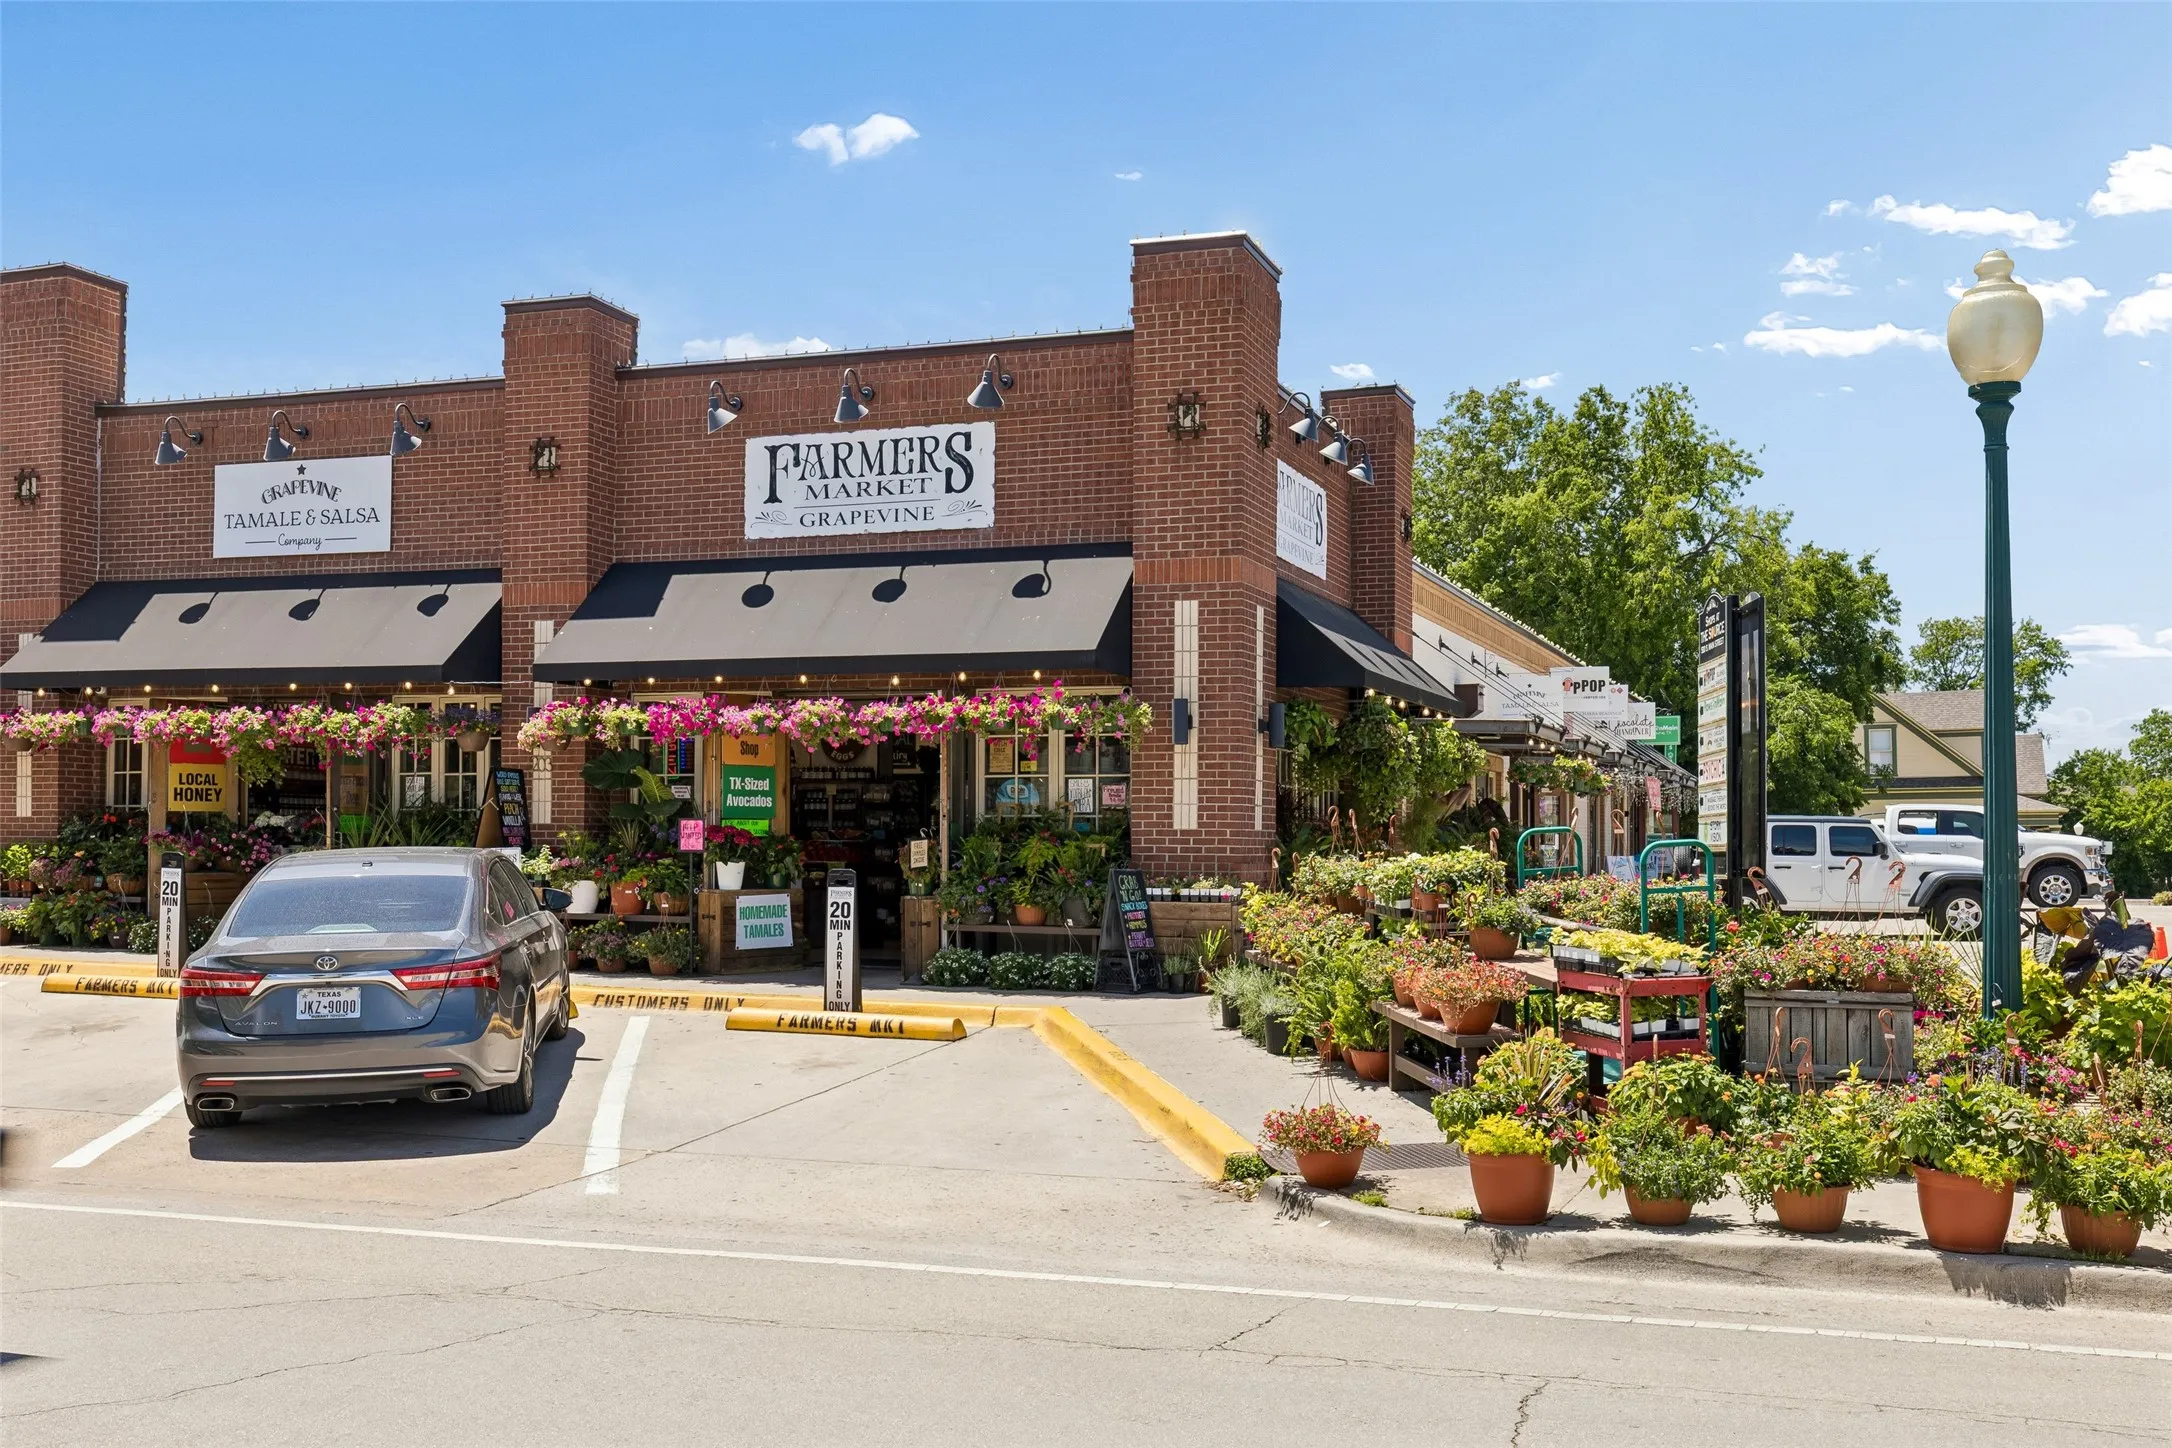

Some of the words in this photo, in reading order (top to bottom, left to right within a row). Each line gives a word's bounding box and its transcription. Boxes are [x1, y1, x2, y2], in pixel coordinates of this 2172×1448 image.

[763, 431, 974, 504] FARMERS
[261, 479, 342, 504] GRAPEVINE
[804, 477, 933, 500] MARKET
[1278, 471, 1323, 546] ARMERS
[224, 511, 301, 529] TAMALE
[305, 509, 316, 525] &
[320, 507, 380, 525] SALSA
[800, 506, 935, 528] GRAPEVINE
[1280, 510, 1313, 540] MARKET
[277, 533, 322, 550] Company
[1278, 535, 1314, 565] GRAPEVINE
[740, 741, 759, 759] Shop
[830, 750, 855, 760] EGGS
[178, 772, 218, 786] LOCAL
[729, 777, 769, 791] TX-Sized
[173, 787, 222, 802] HONEY
[726, 794, 772, 808] Avocados
[162, 881, 178, 896] 20
[1118, 874, 1138, 890] GRAB
[162, 897, 178, 906] MIN
[739, 904, 788, 920] HOMEMADE
[830, 902, 851, 919] 20
[743, 923, 784, 938] TAMALES
[830, 920, 851, 930] MIN
[160, 968, 177, 978] ONLY
[75, 977, 139, 993] FARMERS
[592, 993, 689, 1011] CUSTOMERS
[703, 996, 746, 1012] ONLY
[829, 1001, 850, 1012] ONLY
[777, 1013, 858, 1032] FARMERS
